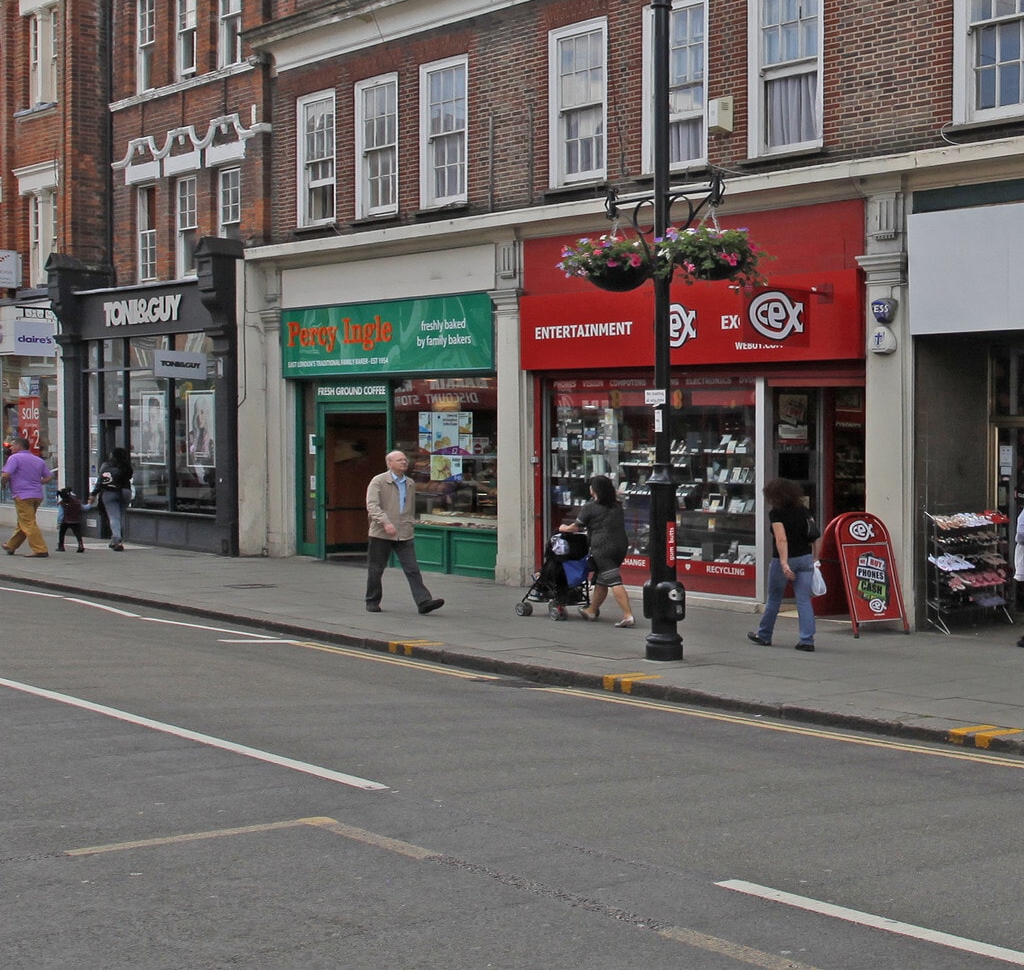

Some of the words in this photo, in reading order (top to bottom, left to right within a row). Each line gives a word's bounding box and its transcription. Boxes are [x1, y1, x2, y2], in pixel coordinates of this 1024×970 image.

[104, 294, 181, 327] TONI&GUY
[421, 320, 443, 332] freshly
[444, 318, 466, 329] baked
[534, 321, 633, 340] ENTERTAINMENT
[17, 335, 53, 344] claire's
[288, 321, 337, 353] Percy
[342, 315, 393, 351] Ingle
[417, 337, 425, 349] by
[426, 335, 447, 348] family
[448, 334, 472, 345] bakers
[317, 387, 335, 396] FRESH
[335, 386, 362, 396] GROUND
[363, 385, 386, 395] COFFEE
[22, 400, 39, 420] sale
[706, 565, 745, 576] RECYCLING
[858, 568, 884, 580] PHONES
[861, 581, 882, 595] CASH
